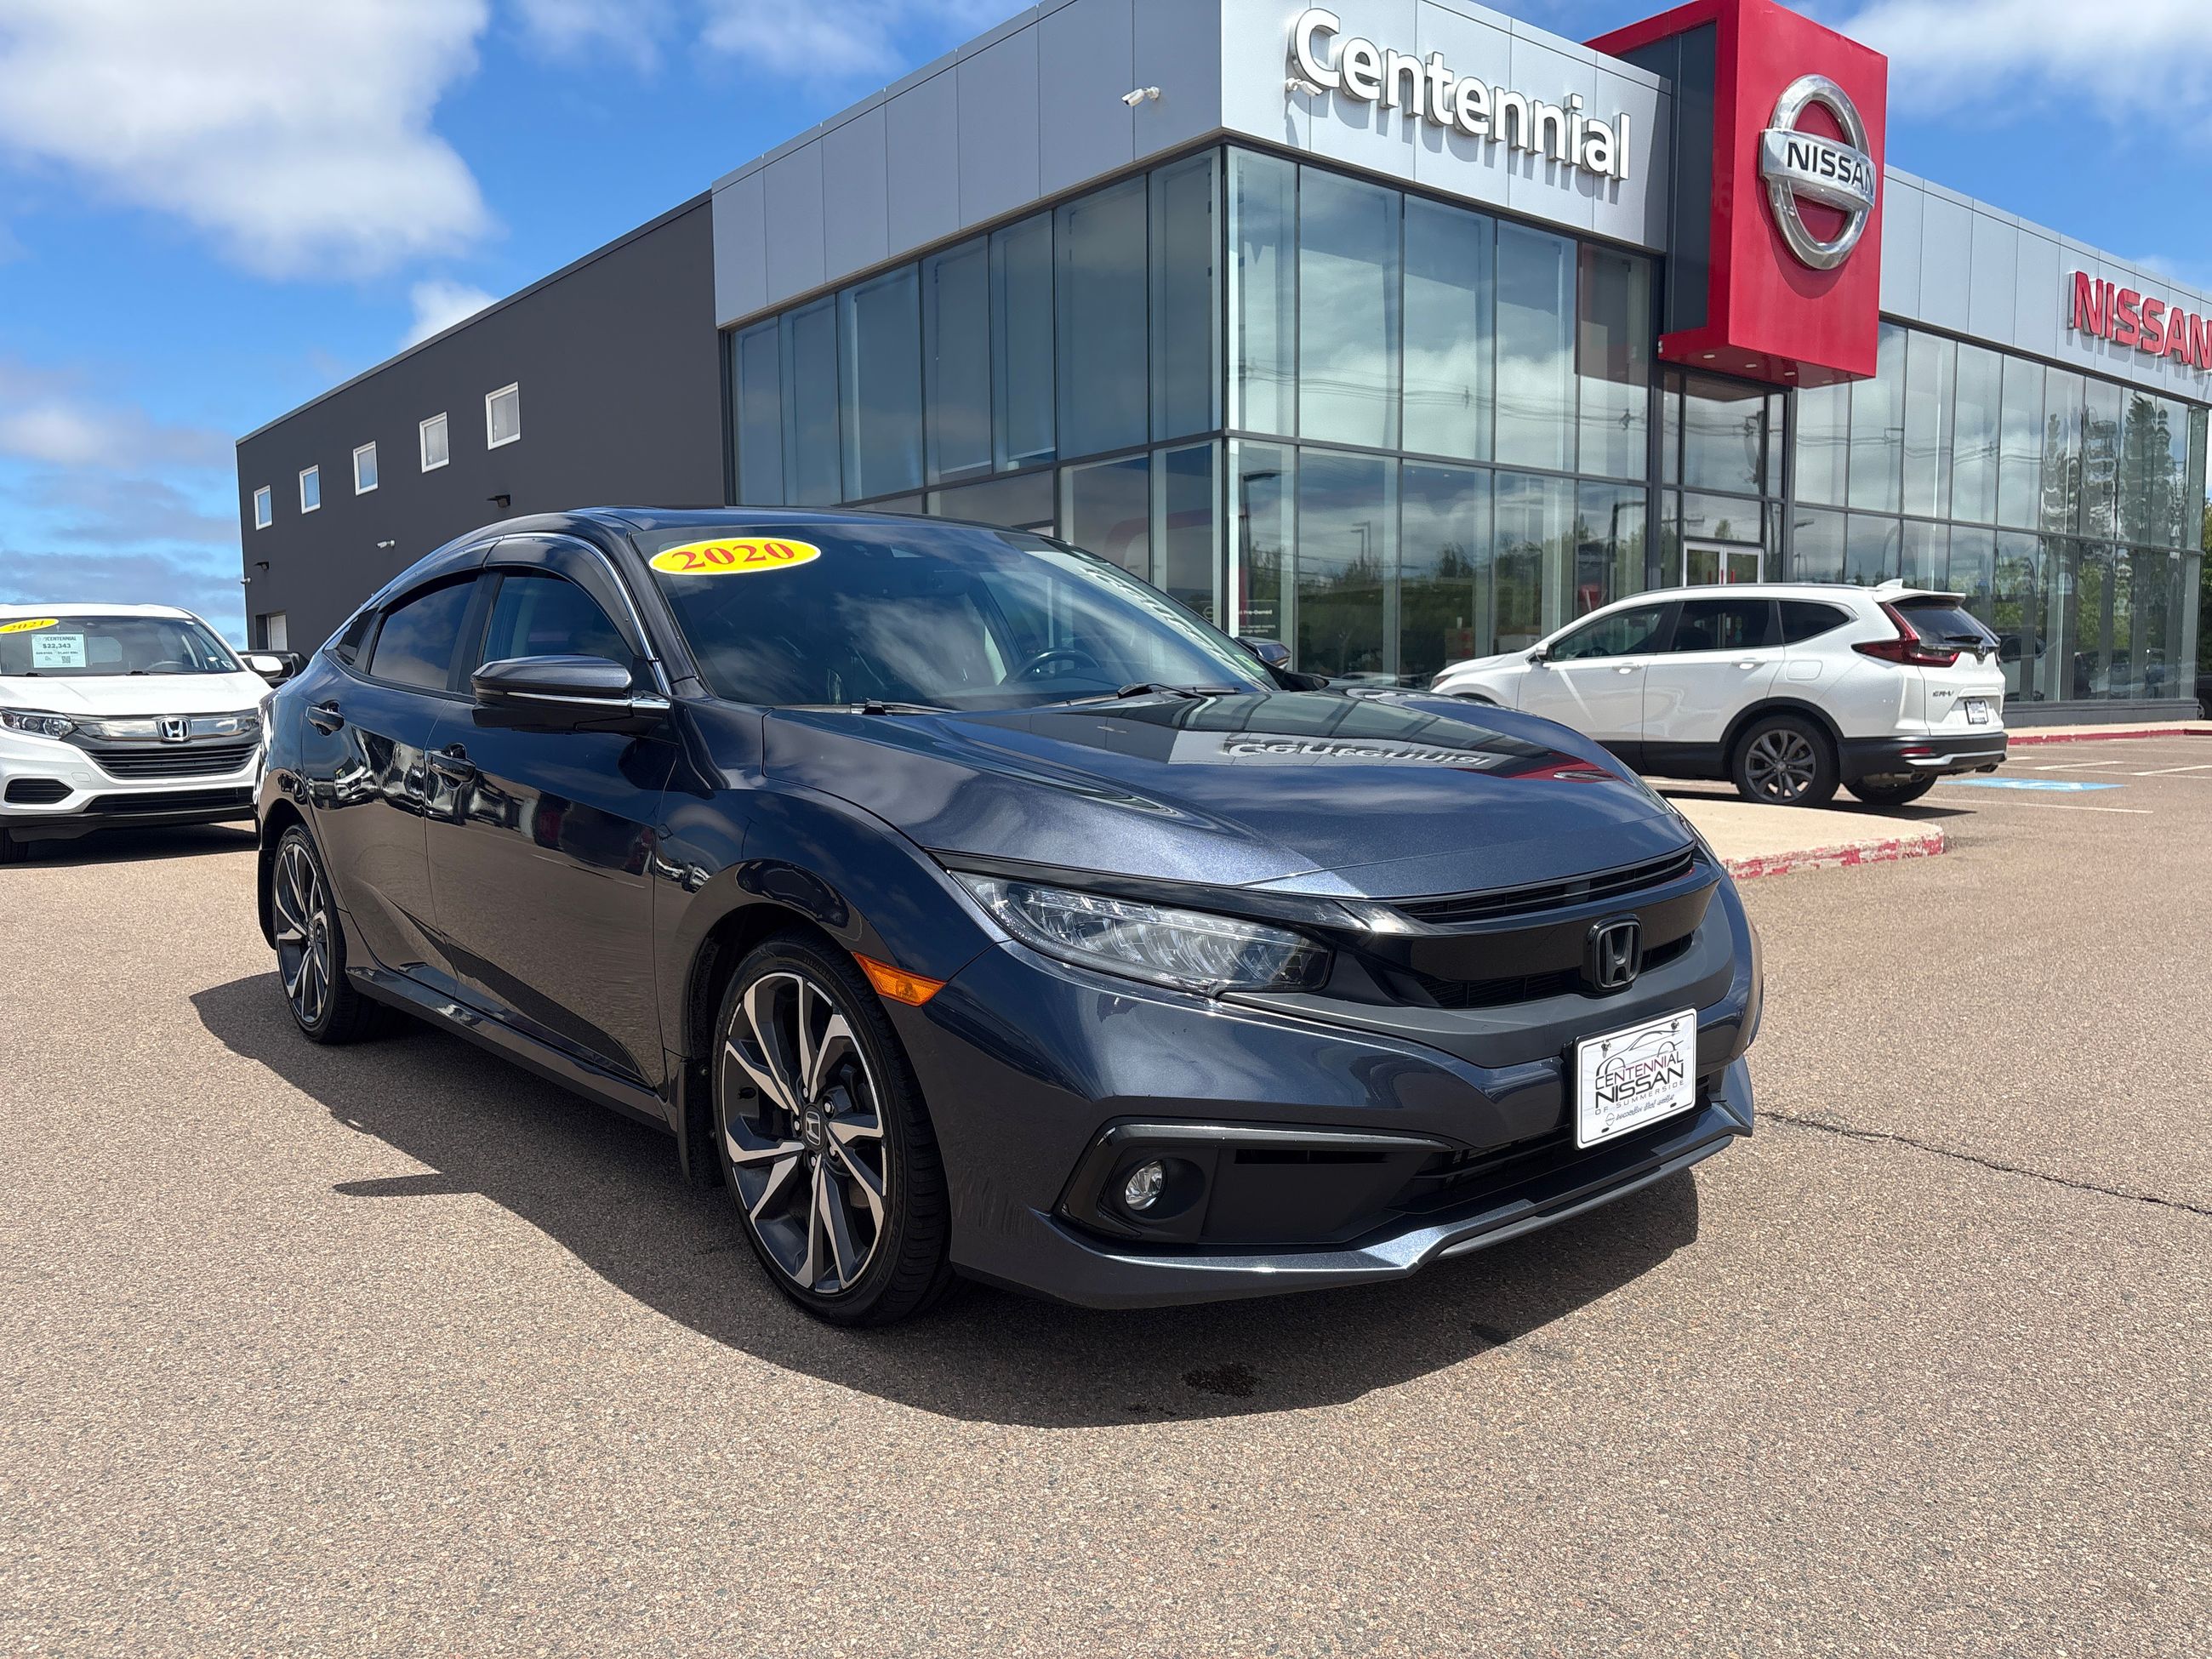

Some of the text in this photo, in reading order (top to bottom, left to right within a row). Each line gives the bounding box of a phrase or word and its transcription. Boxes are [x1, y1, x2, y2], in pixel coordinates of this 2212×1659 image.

[1292, 8, 1631, 181] Centennial
[1787, 141, 1874, 197] NISSAN
[2072, 271, 2212, 371] NISSAN
[671, 543, 795, 571] 2020
[9, 620, 44, 630] 2021
[1594, 1051, 1684, 1091] CENTENNIAL
[1595, 1062, 1684, 1109] NISSAN
[1594, 1106, 1609, 1115] OF
[1616, 1080, 1685, 1109] SUMMERSIDE
